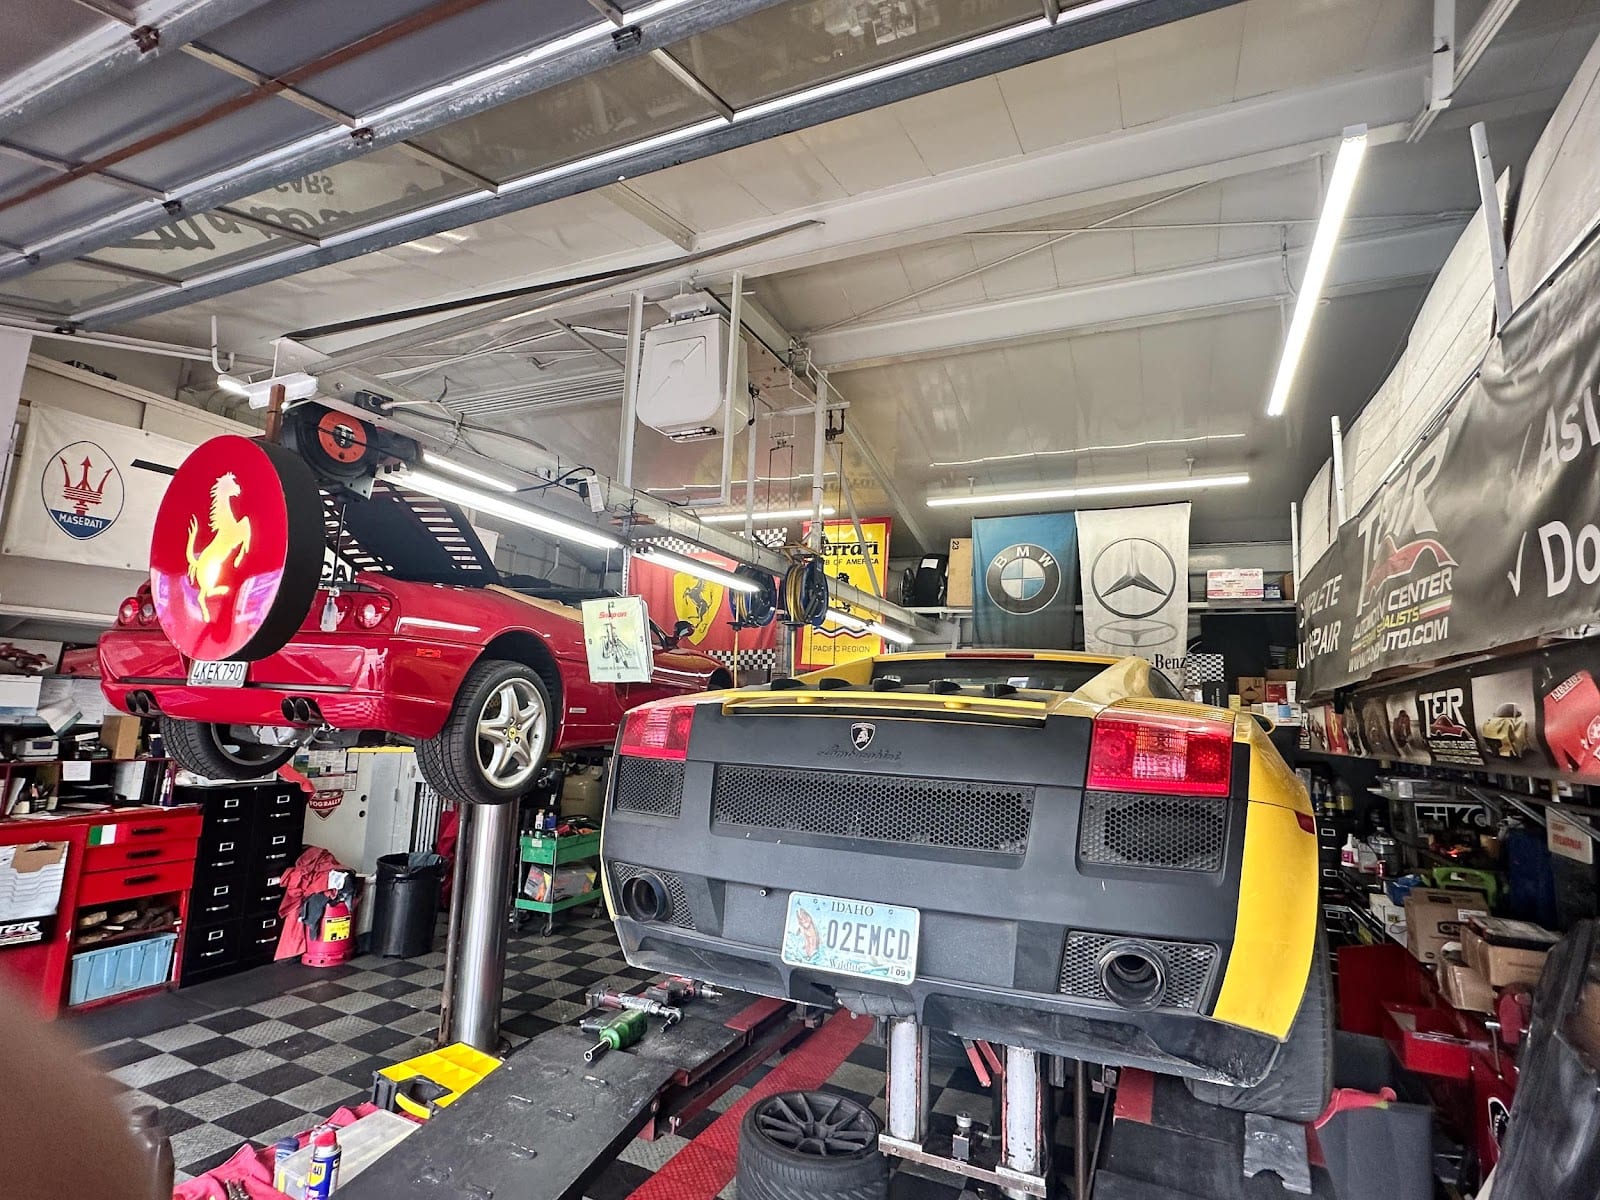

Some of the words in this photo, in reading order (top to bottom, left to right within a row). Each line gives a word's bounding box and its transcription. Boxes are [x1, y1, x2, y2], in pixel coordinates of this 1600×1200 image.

[58, 513, 103, 529] MASERATI
[951, 540, 960, 551] 23
[994, 546, 1054, 569] BMW
[1388, 567, 1453, 612] CENTER
[841, 645, 870, 653] REGION
[193, 662, 243, 681] 4KEK790
[831, 901, 874, 917] IDAHO
